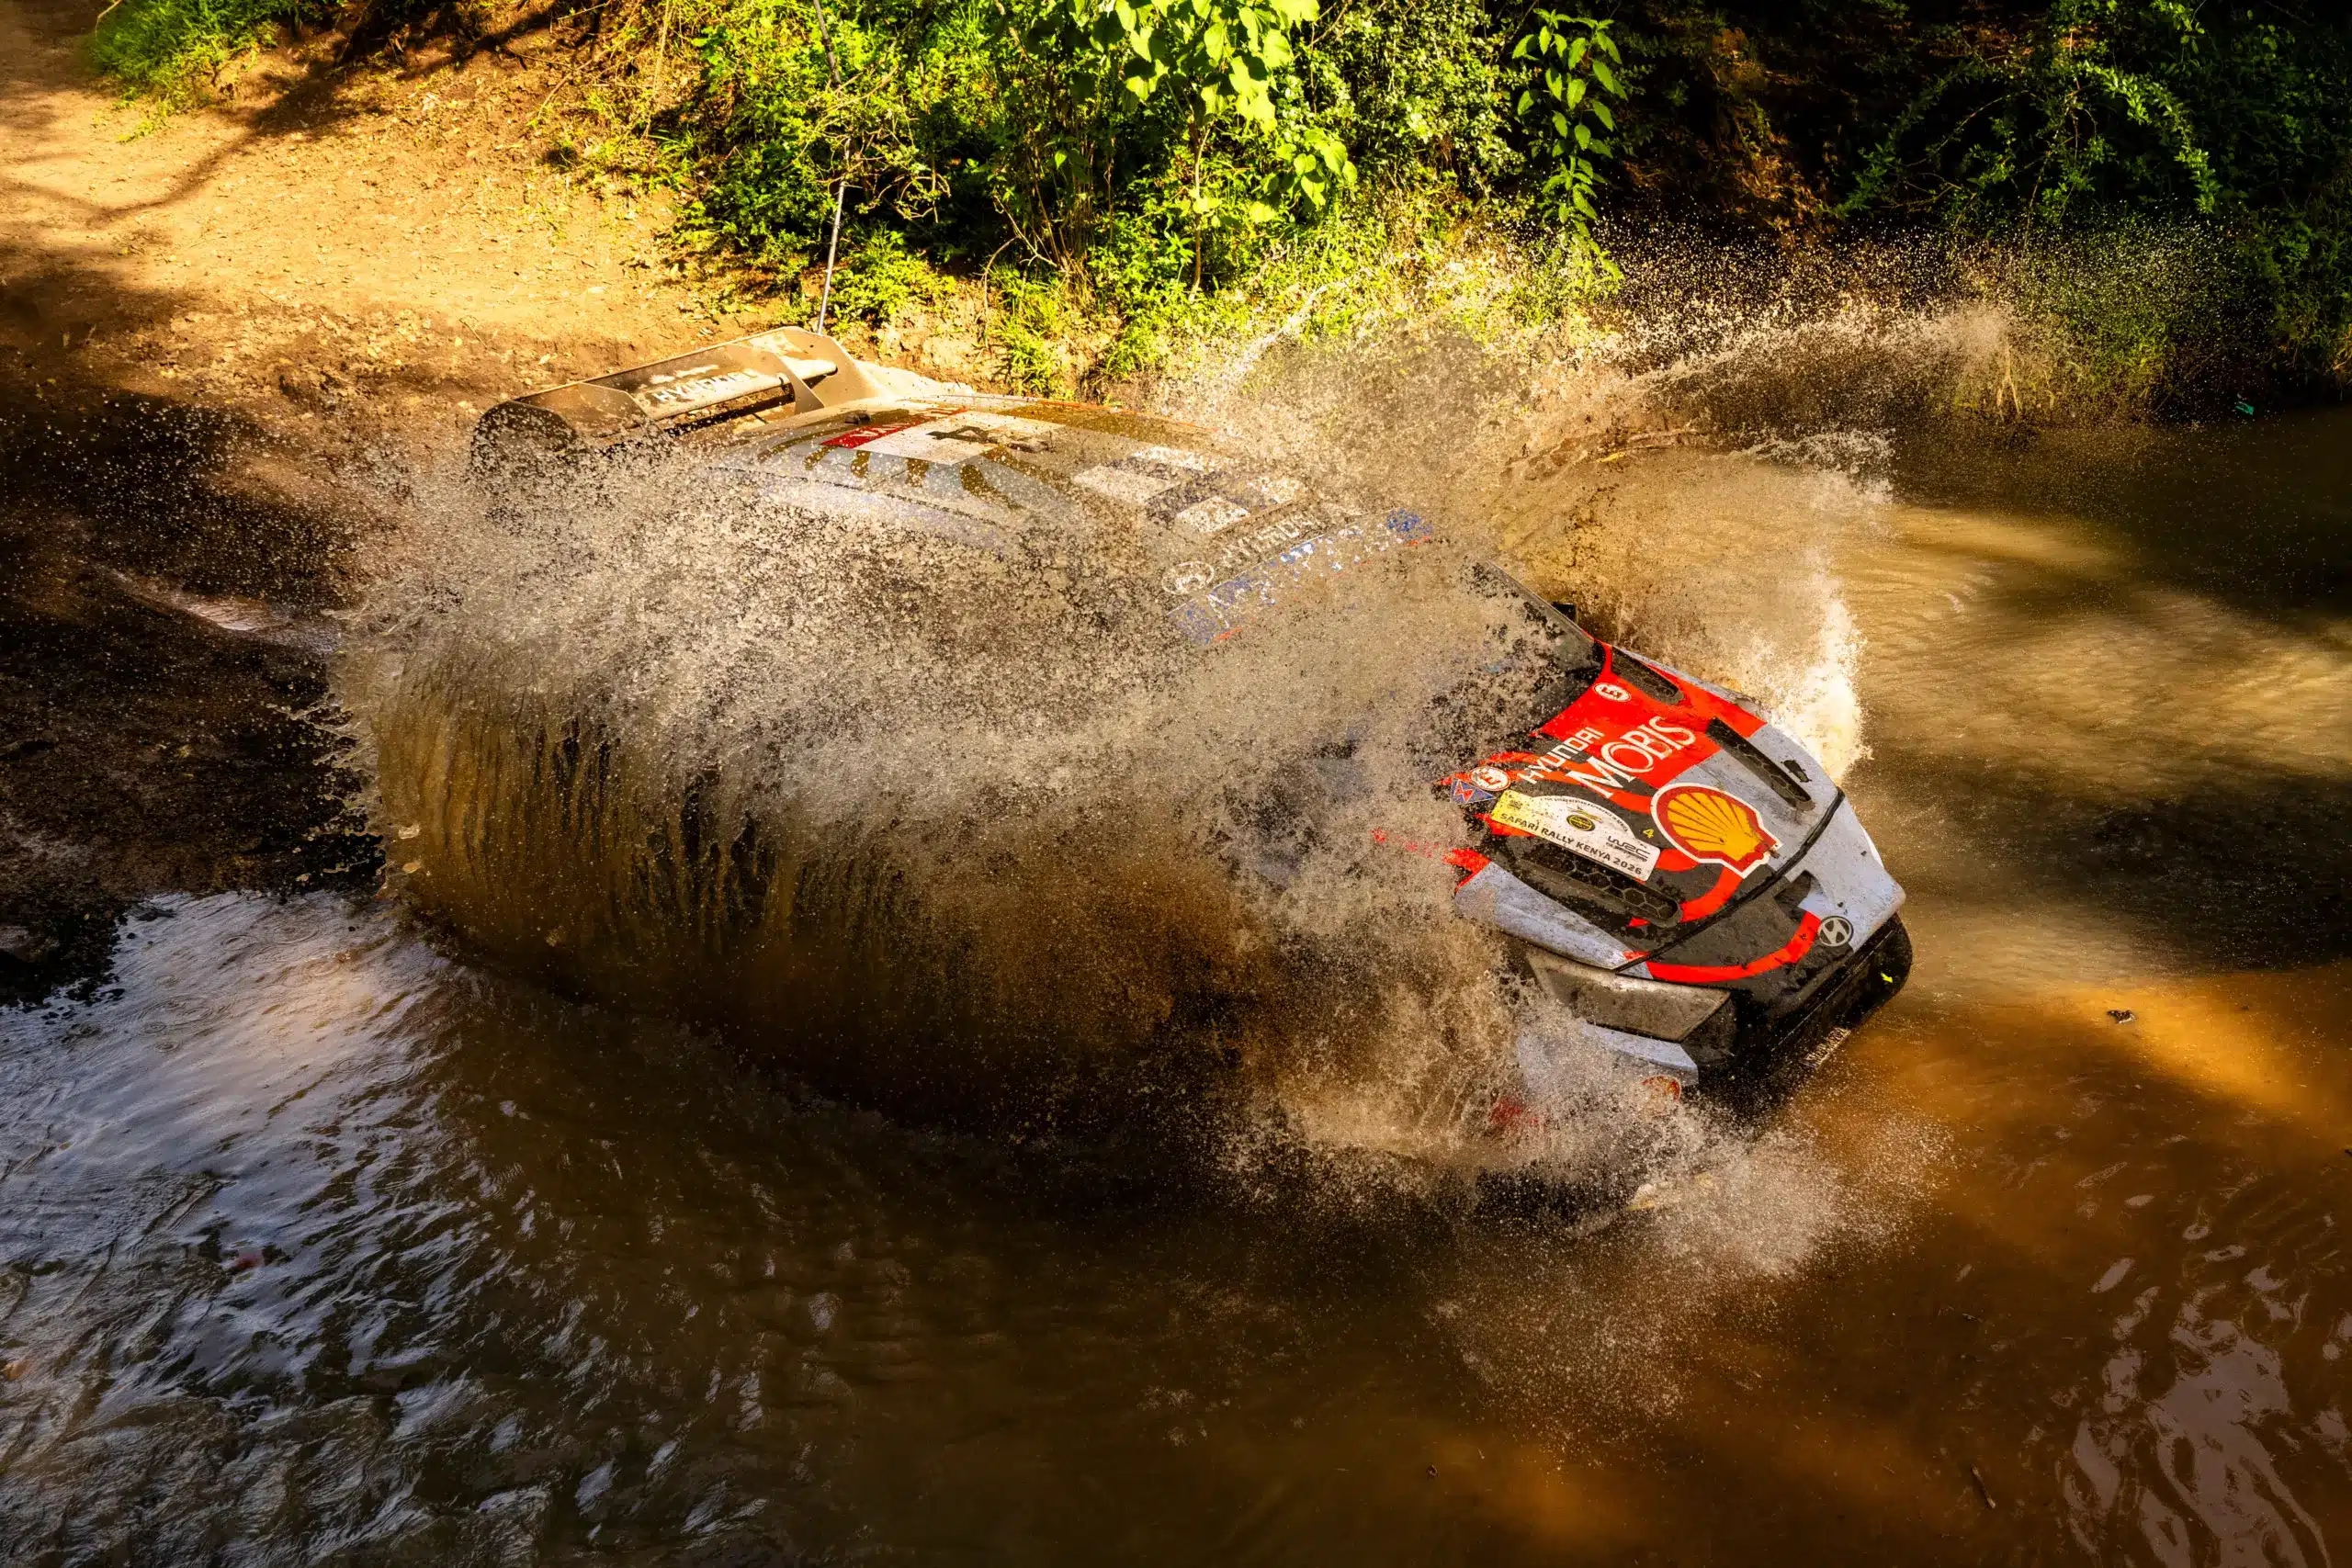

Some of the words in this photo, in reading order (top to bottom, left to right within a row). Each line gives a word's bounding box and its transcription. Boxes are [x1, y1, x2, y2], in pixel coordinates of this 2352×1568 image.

[1517, 727, 1605, 784] HYUNDAI
[1566, 716, 1696, 798] MOBIS
[1500, 813, 1538, 831] SAFARI
[1542, 828, 1574, 844] RALLY
[1576, 841, 1611, 861] KENYA
[1613, 857, 1642, 874] 2026
[1607, 835, 1650, 859] WRC
[1643, 829, 1654, 838] 4
